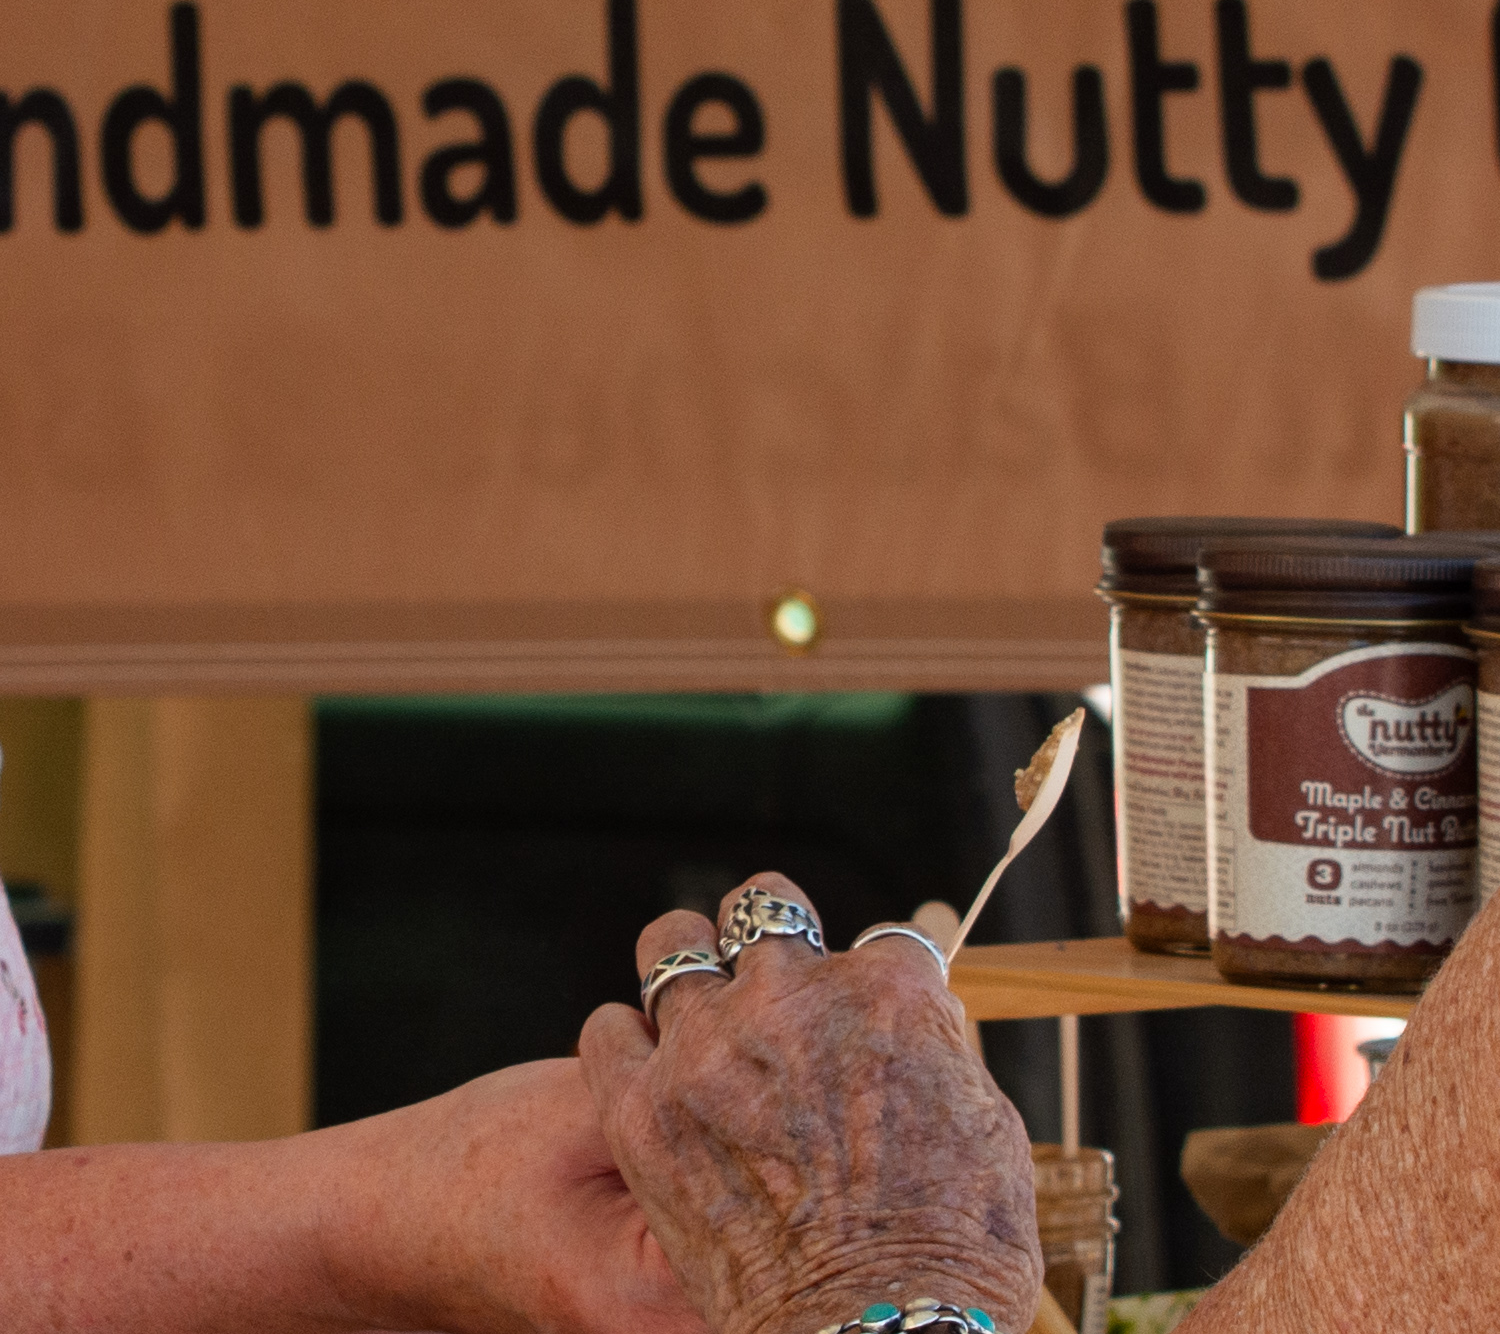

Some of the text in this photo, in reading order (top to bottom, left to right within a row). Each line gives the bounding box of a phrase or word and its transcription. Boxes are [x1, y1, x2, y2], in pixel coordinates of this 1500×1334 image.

[1301, 781, 1407, 814] Maple &
[1295, 811, 1436, 848] Triple Nut
